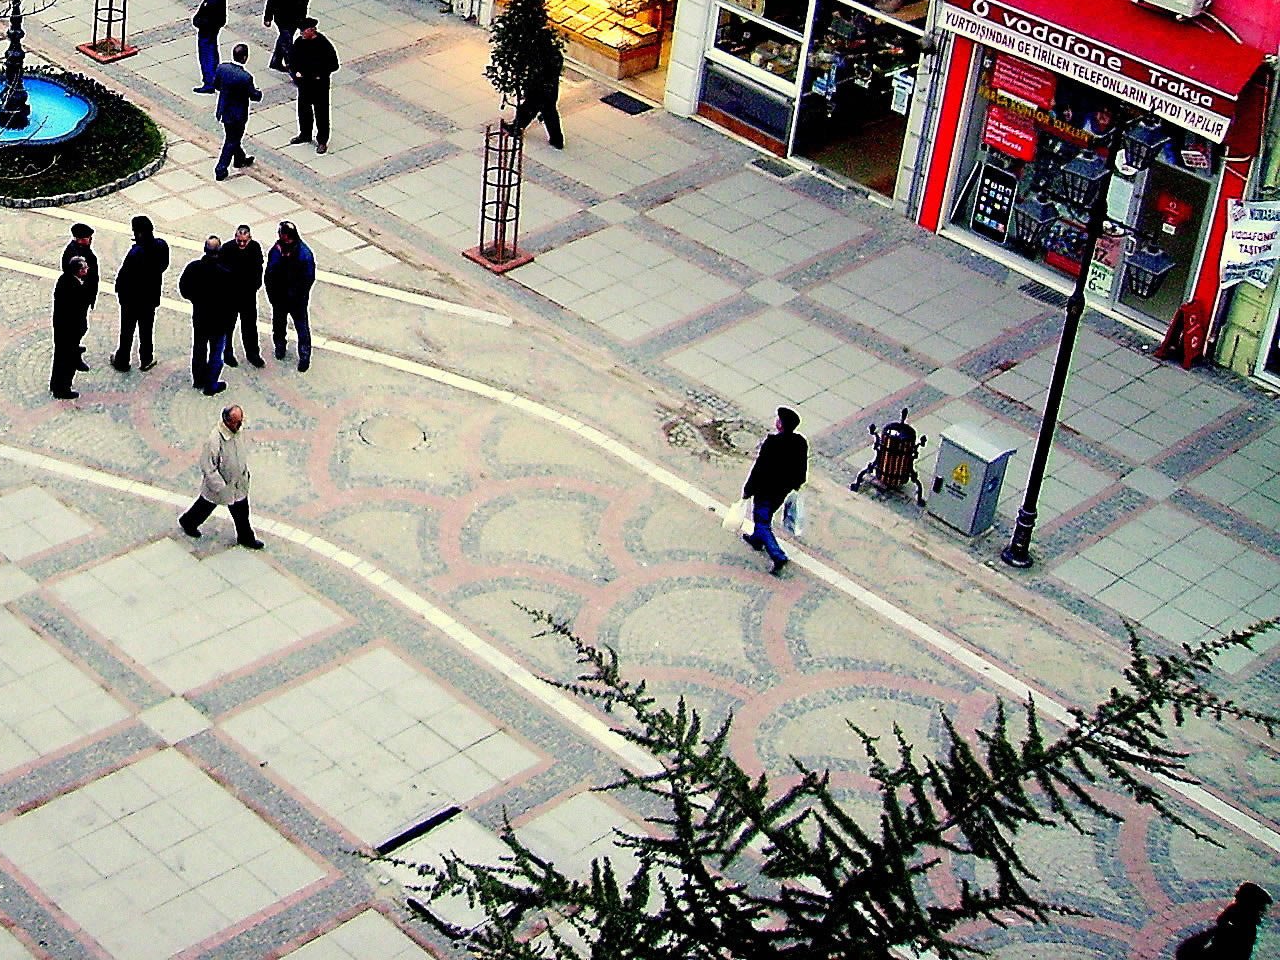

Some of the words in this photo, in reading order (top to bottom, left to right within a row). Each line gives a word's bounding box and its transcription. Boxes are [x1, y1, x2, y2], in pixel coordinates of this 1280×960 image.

[945, 11, 1015, 51] YURTDIŞINDAN
[1017, 40, 1070, 73] GETİRİLEN
[1073, 62, 1148, 105] TELEFONLARIN
[1149, 94, 1182, 118] KAYDI
[1184, 109, 1224, 138] YAPILIR
[1003, 12, 1122, 72] vodafone
[1149, 69, 1213, 108] Trakya
